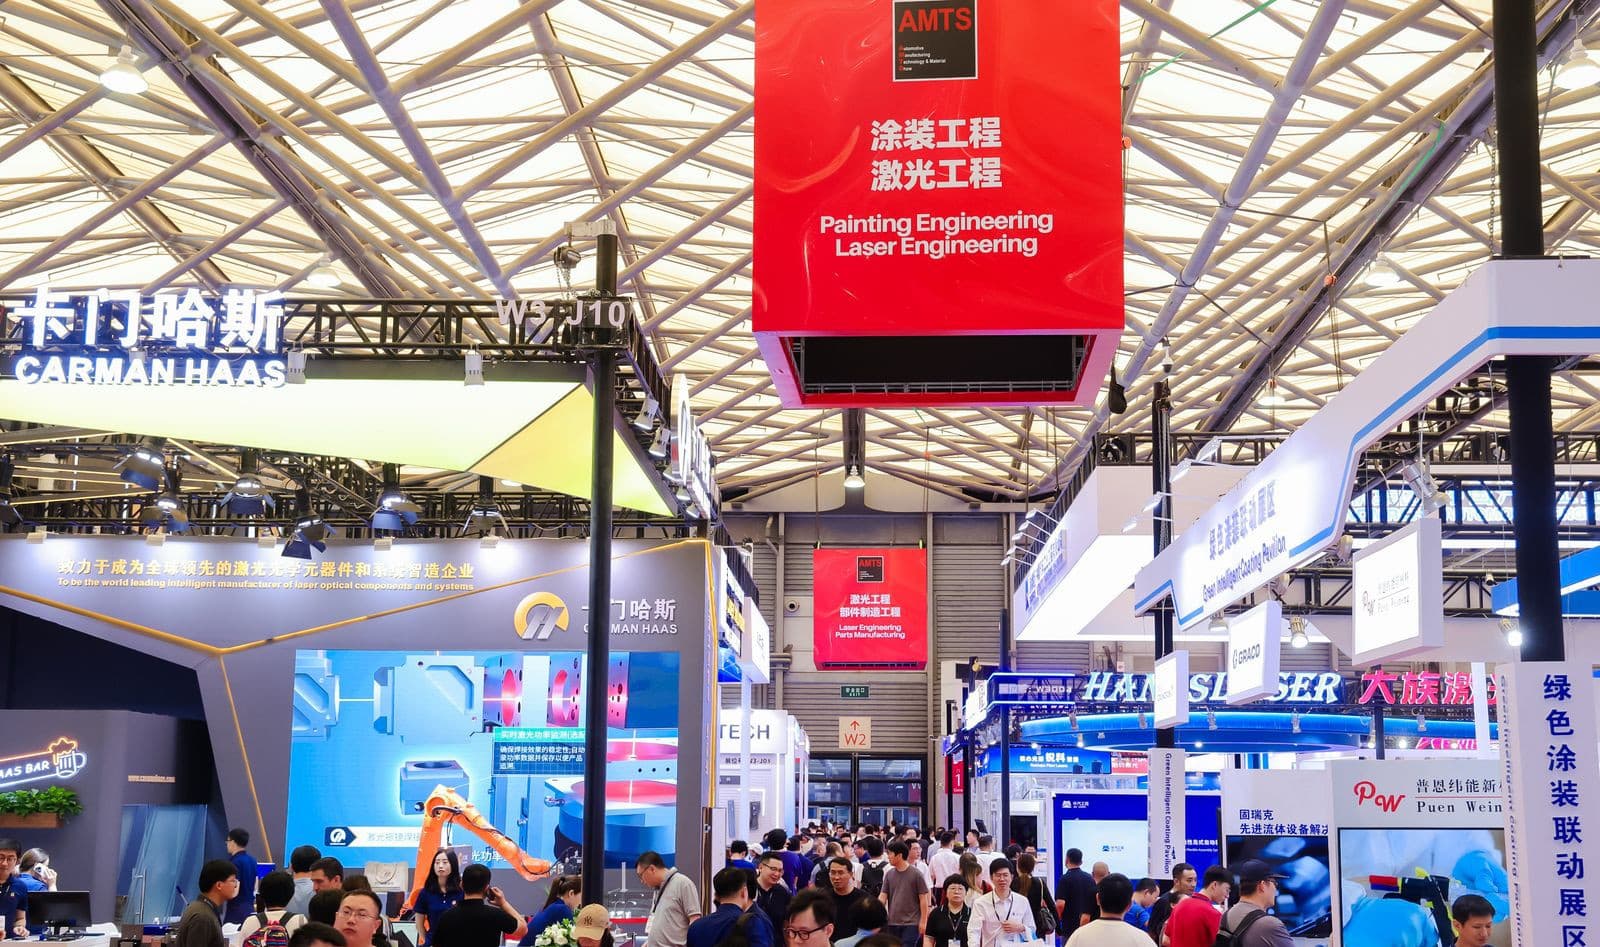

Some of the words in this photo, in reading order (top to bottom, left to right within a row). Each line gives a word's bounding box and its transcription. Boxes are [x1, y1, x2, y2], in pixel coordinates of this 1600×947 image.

[898, 7, 972, 33] AMTS
[870, 117, 1002, 151] 涂装工程
[870, 158, 1002, 191] 激光工程
[820, 214, 912, 237] Painting
[916, 211, 1054, 237] Engineering
[835, 238, 897, 257] Laser
[900, 234, 1038, 259] Engineering
[15, 286, 285, 353] 卡门哈斯
[496, 300, 546, 326] W3
[566, 301, 626, 327] J10
[15, 356, 175, 387] CARMAN
[185, 358, 286, 388] HAAS
[859, 559, 882, 568] AMTS
[1241, 557, 1262, 578] Coating
[58, 578, 69, 587] To
[71, 578, 83, 587] be
[85, 578, 100, 587] the
[102, 578, 129, 587] world
[131, 579, 166, 589] leading
[168, 579, 216, 590] intelligent
[218, 580, 281, 589] manufacturer
[283, 581, 294, 589] of
[295, 581, 319, 590] laser
[320, 581, 353, 591] optical
[354, 582, 413, 592] components
[415, 582, 433, 590] and
[434, 583, 475, 592] systems
[582, 599, 677, 621] 门哈斯
[850, 594, 891, 605] 激光工程
[839, 607, 901, 617] 部件制造工程
[583, 624, 639, 634] MAN
[642, 624, 678, 634] HAAS
[854, 632, 906, 640] Manufacturing
[859, 624, 902, 632] Engineering
[1238, 644, 1261, 665] GRACO
[1082, 671, 1211, 703] HAS
[1209, 671, 1342, 703] LSER
[844, 733, 867, 746] W2
[25, 760, 50, 774] BAR
[1164, 752, 1172, 776] Green
[1163, 777, 1172, 815] Intelligent
[1416, 778, 1503, 793] 普恩纬能新
[1239, 809, 1274, 821] 固瑞克
[1417, 800, 1455, 813] Puen
[1542, 674, 1588, 947] 绿色涂装联动展区
[1163, 816, 1172, 844] Coating
[1163, 845, 1172, 874] Pavilion
